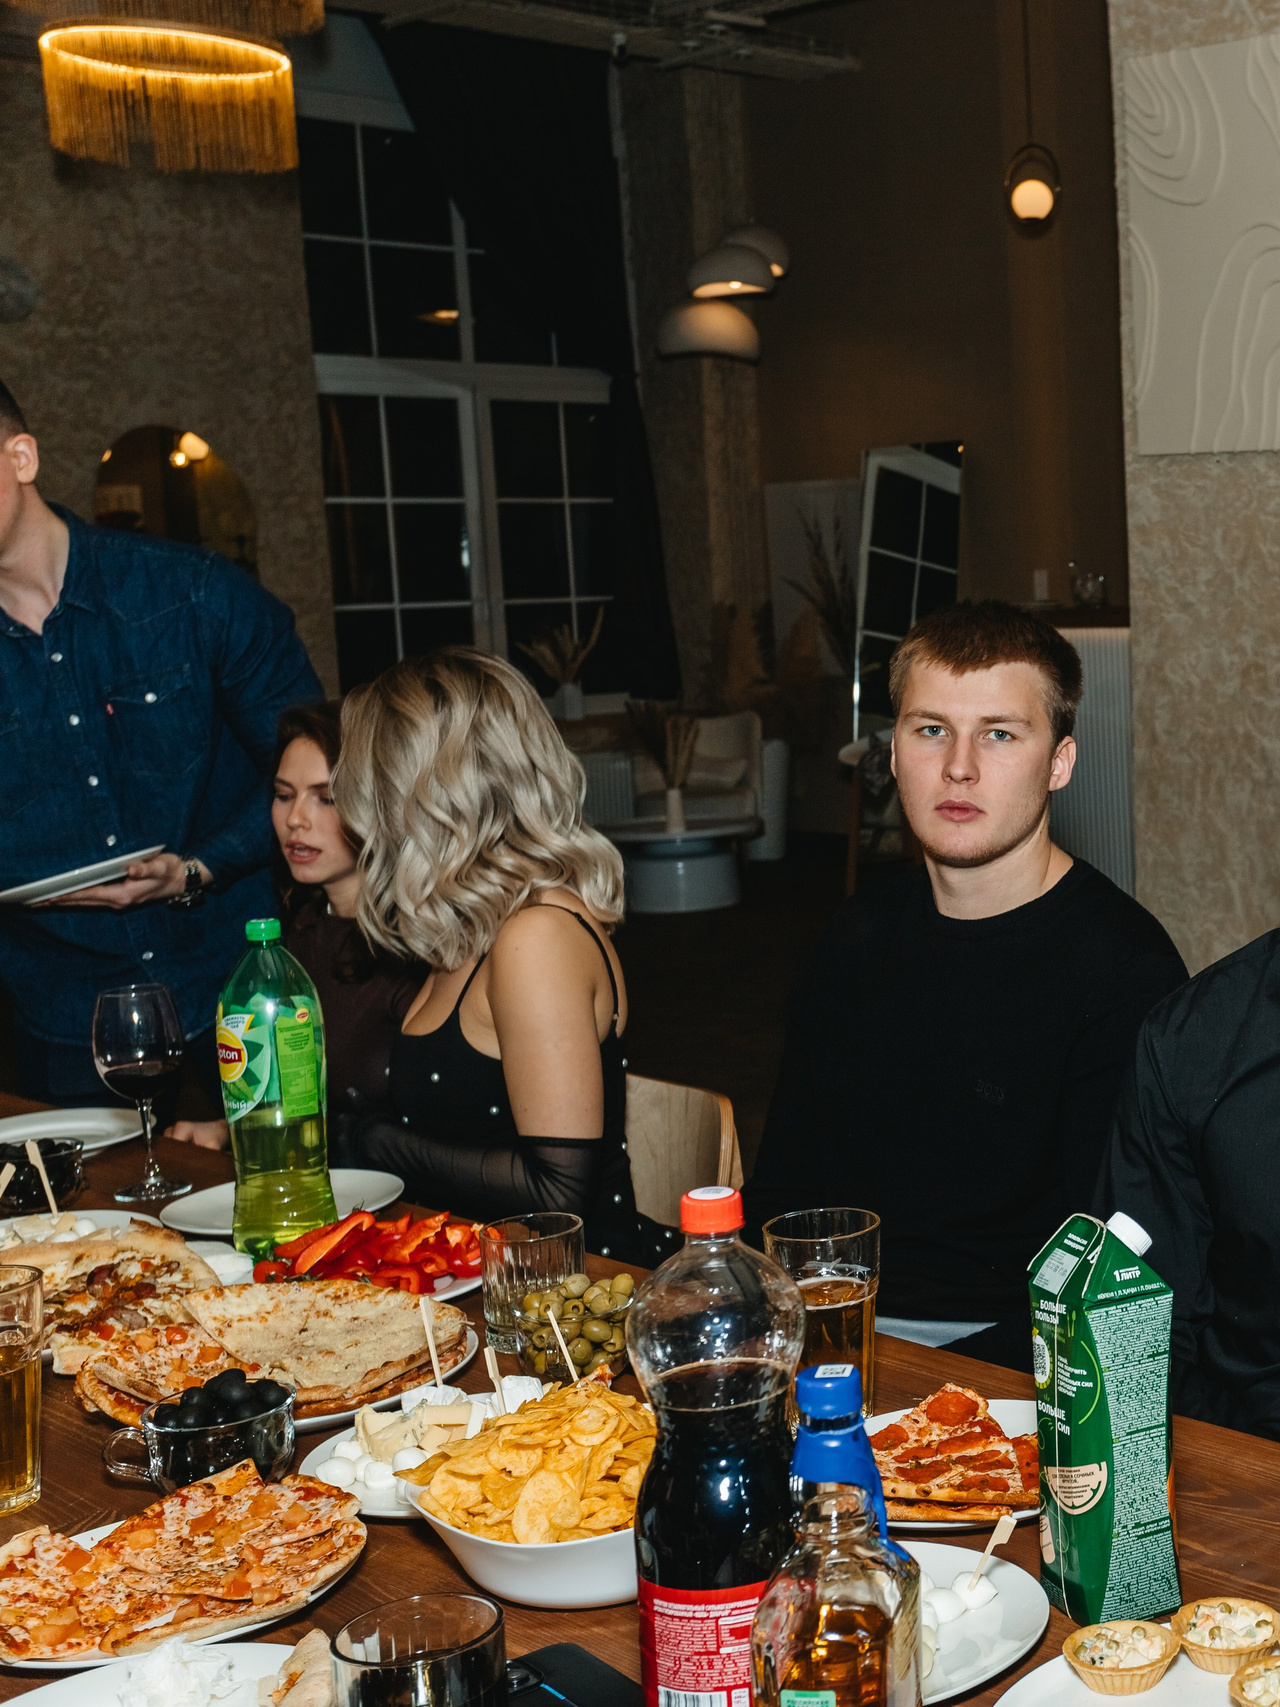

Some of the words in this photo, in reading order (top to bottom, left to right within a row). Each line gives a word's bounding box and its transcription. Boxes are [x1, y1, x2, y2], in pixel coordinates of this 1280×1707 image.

[218, 1048, 238, 1060] pton
[1113, 1270, 1120, 1282] 1
[1120, 1270, 1141, 1281] ЛИТР
[1040, 1299, 1067, 1315] БОЛЬШЕ
[1037, 1400, 1066, 1421] БОЛЬШЕ
[1057, 1421, 1071, 1436] СИЛ
